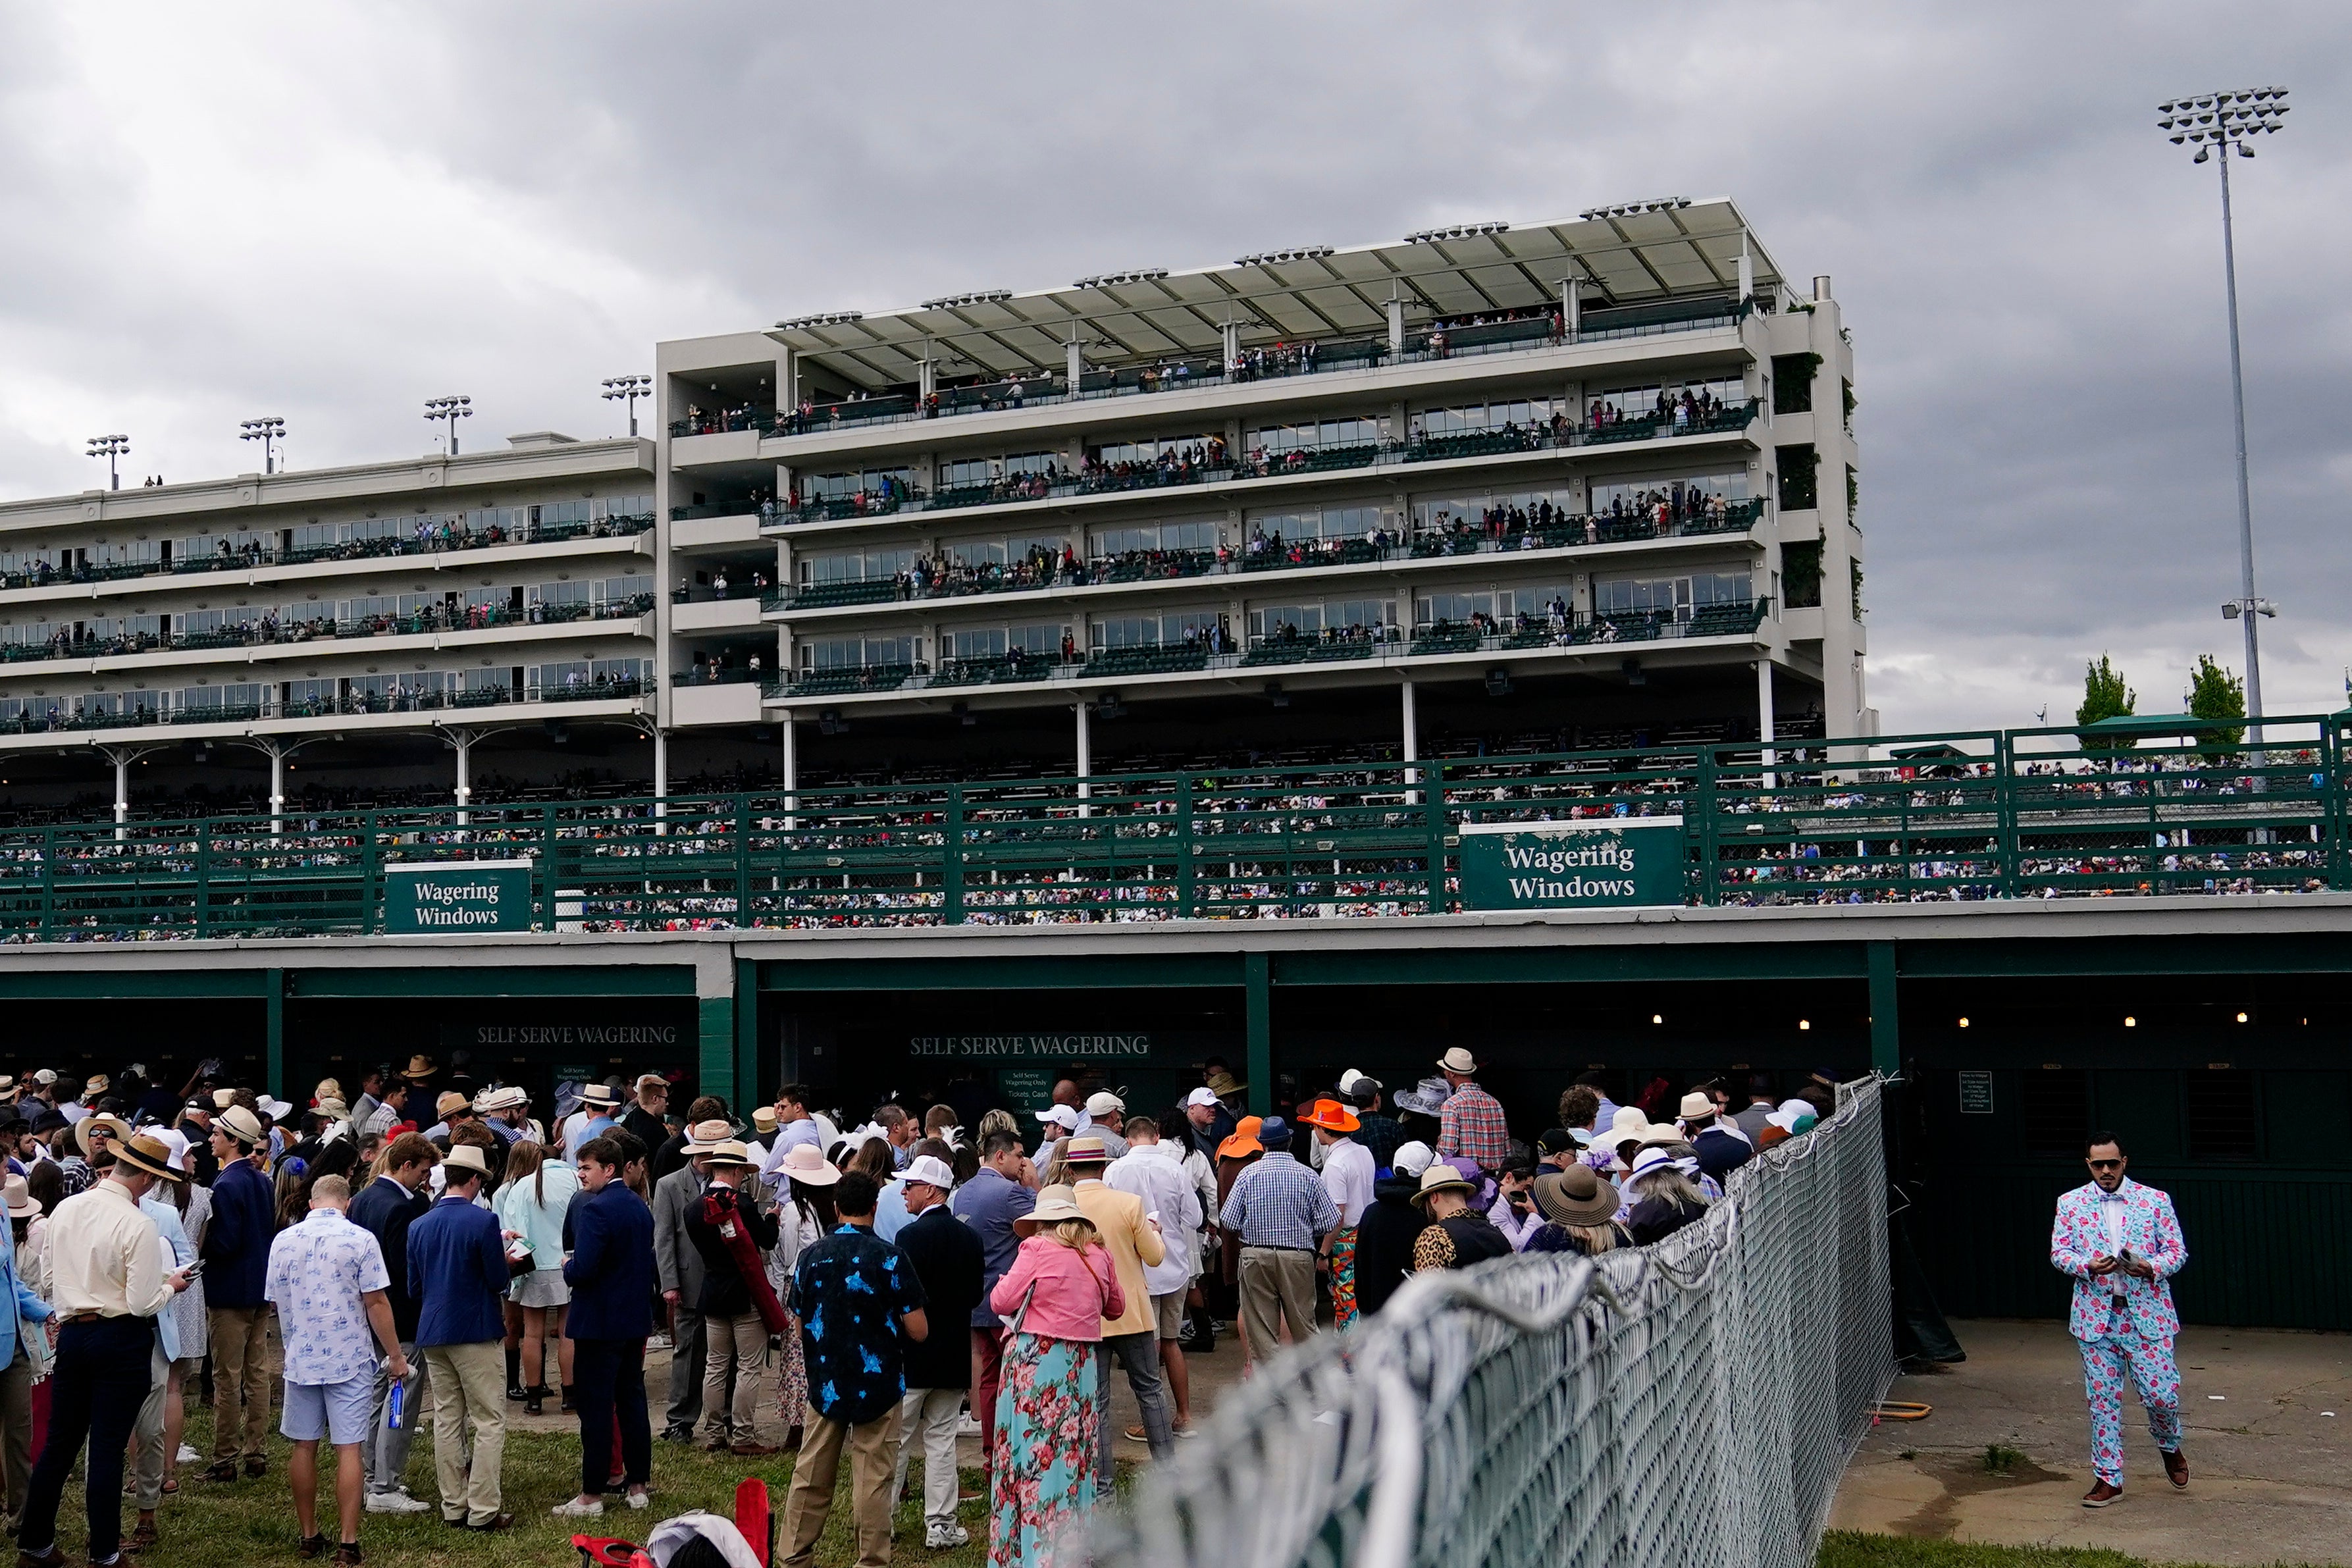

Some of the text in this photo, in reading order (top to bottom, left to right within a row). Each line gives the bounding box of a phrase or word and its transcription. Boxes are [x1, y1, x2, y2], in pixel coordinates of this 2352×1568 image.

[1507, 845, 1635, 874] Wagering
[415, 882, 500, 905] Wagering
[1509, 875, 1636, 899] Windows
[415, 907, 498, 925] Windows
[477, 1026, 677, 1043] SELF SERVE WAGERING
[910, 1036, 1149, 1055] SELF SERVE WAGERING
